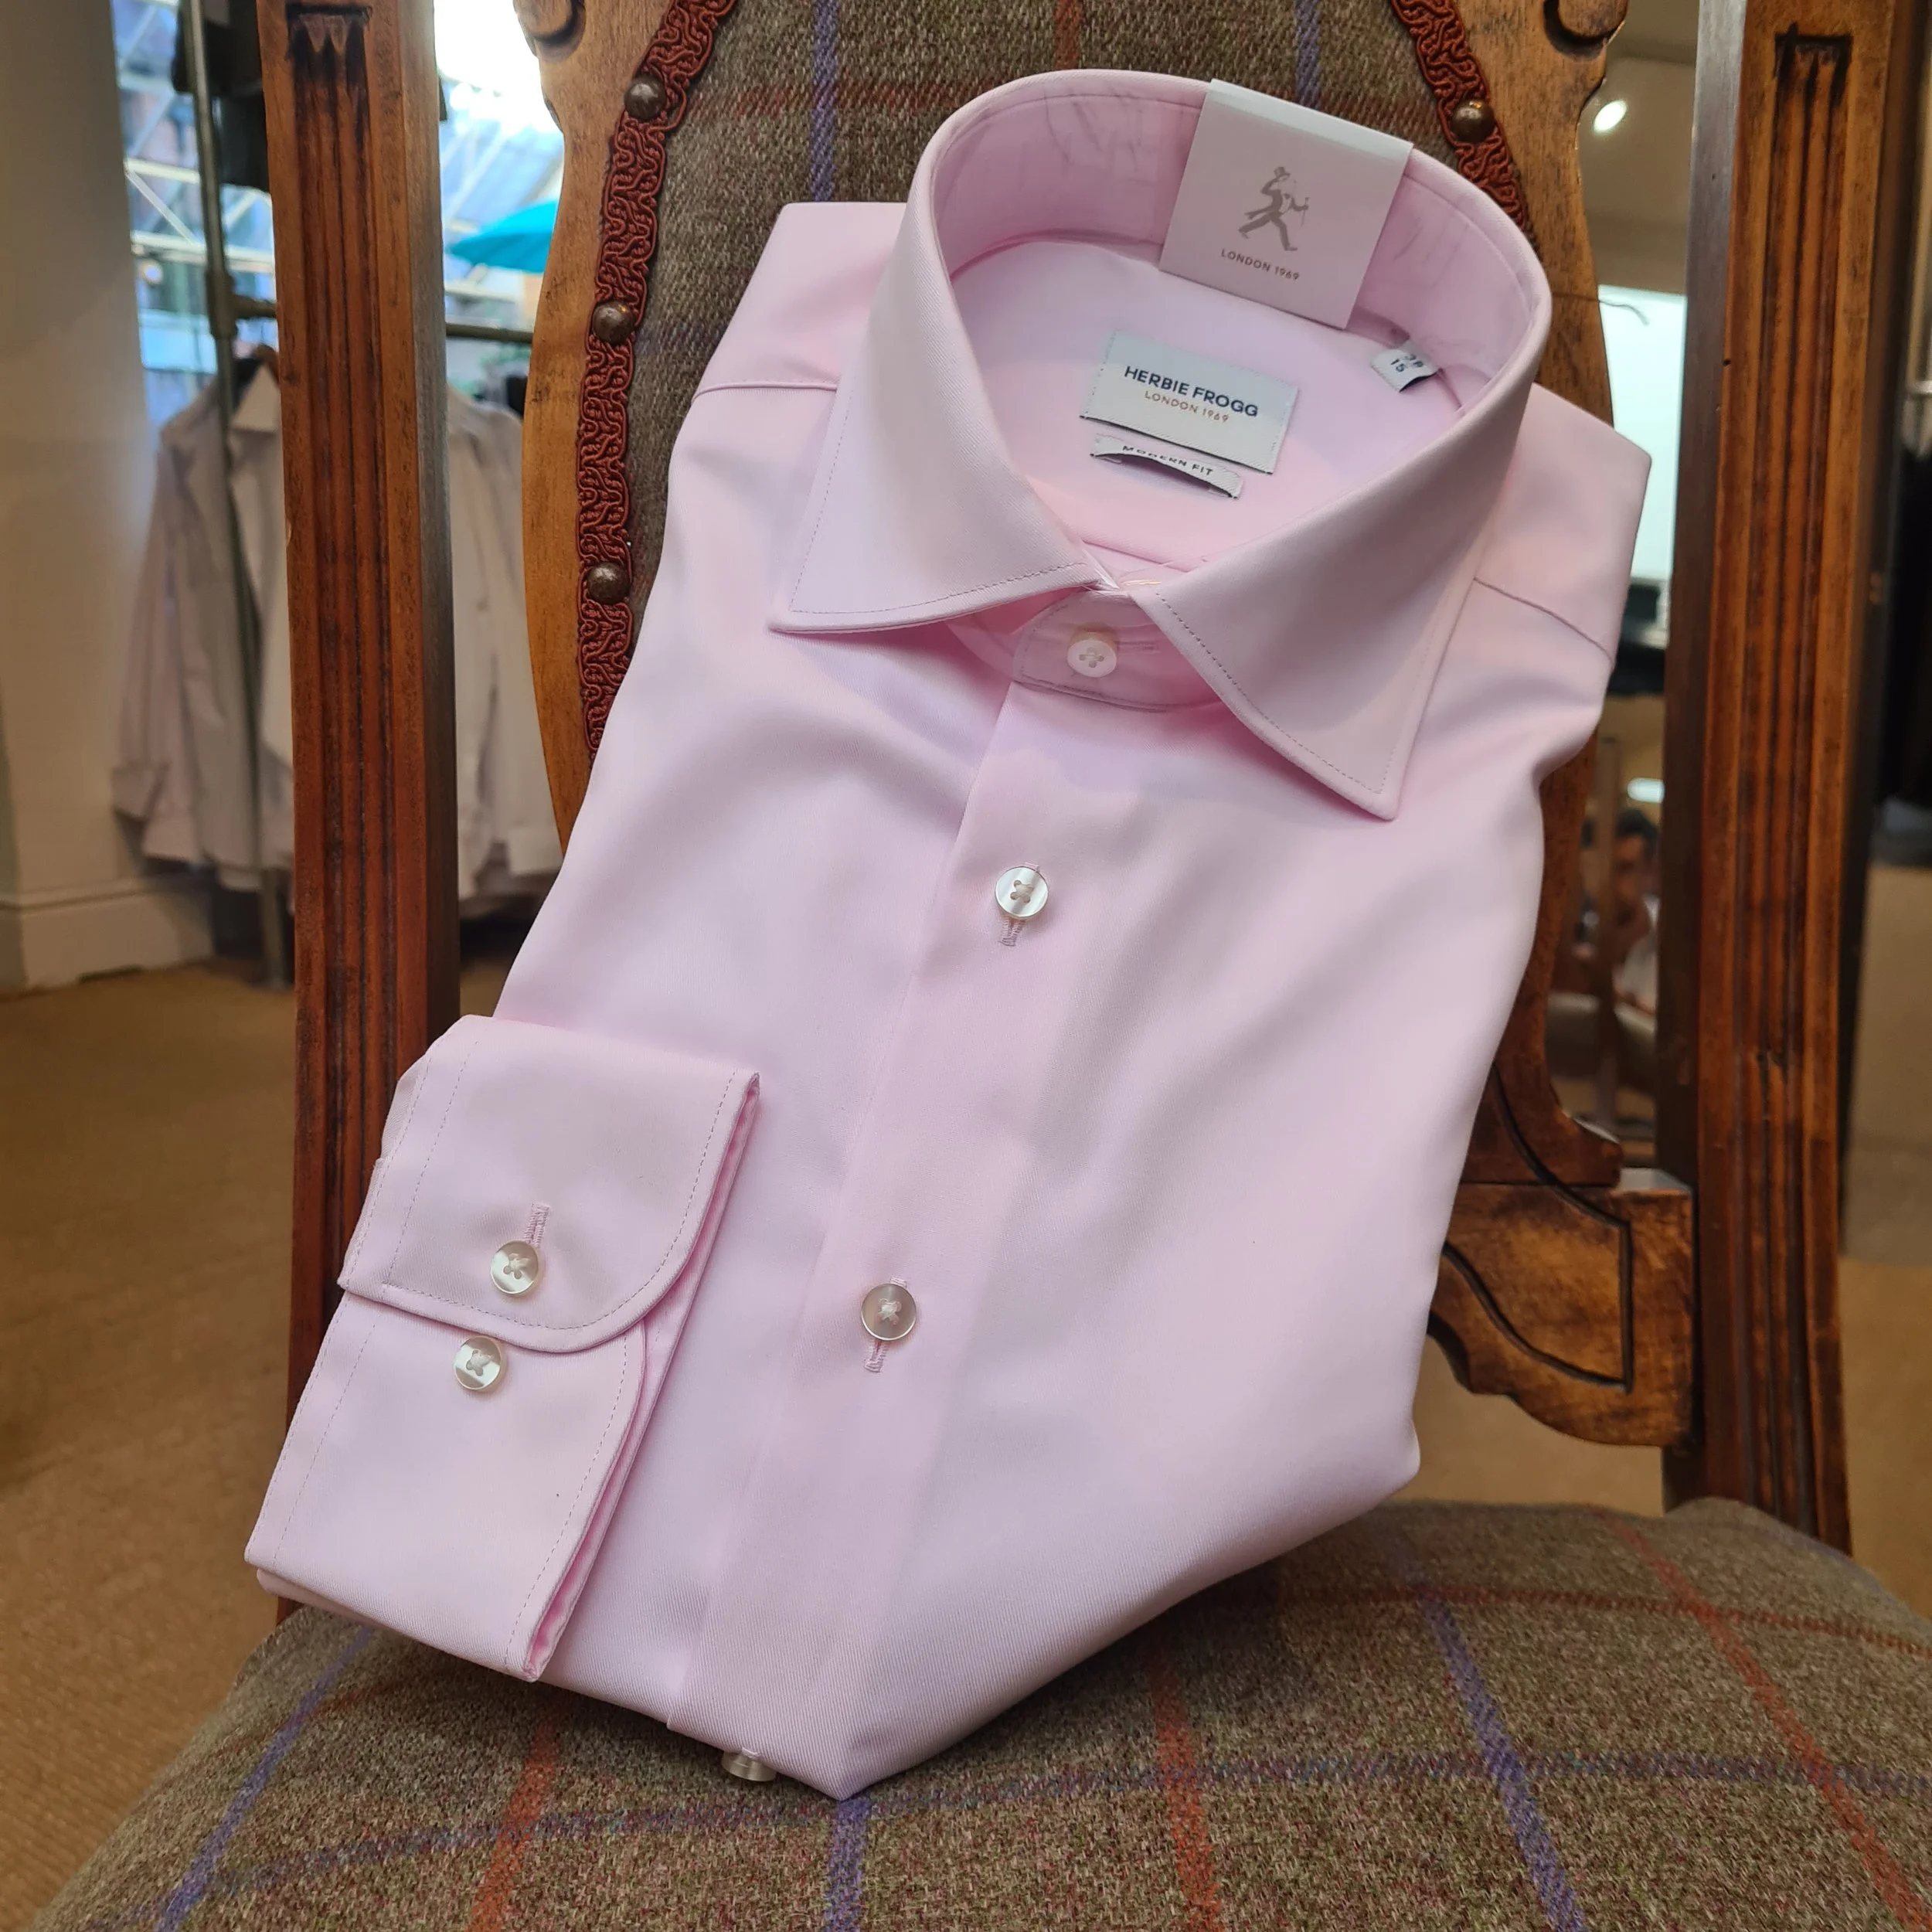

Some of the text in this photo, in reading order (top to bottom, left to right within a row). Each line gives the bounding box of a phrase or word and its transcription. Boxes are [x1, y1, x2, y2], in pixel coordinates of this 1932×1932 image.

[1220, 248, 1300, 281] LONDON 1969
[1390, 358, 1406, 372] 15
[1124, 366, 1259, 417] HERBIE FROGG
[1144, 390, 1230, 423] LONDON 1969
[1191, 464, 1213, 476] FIT
